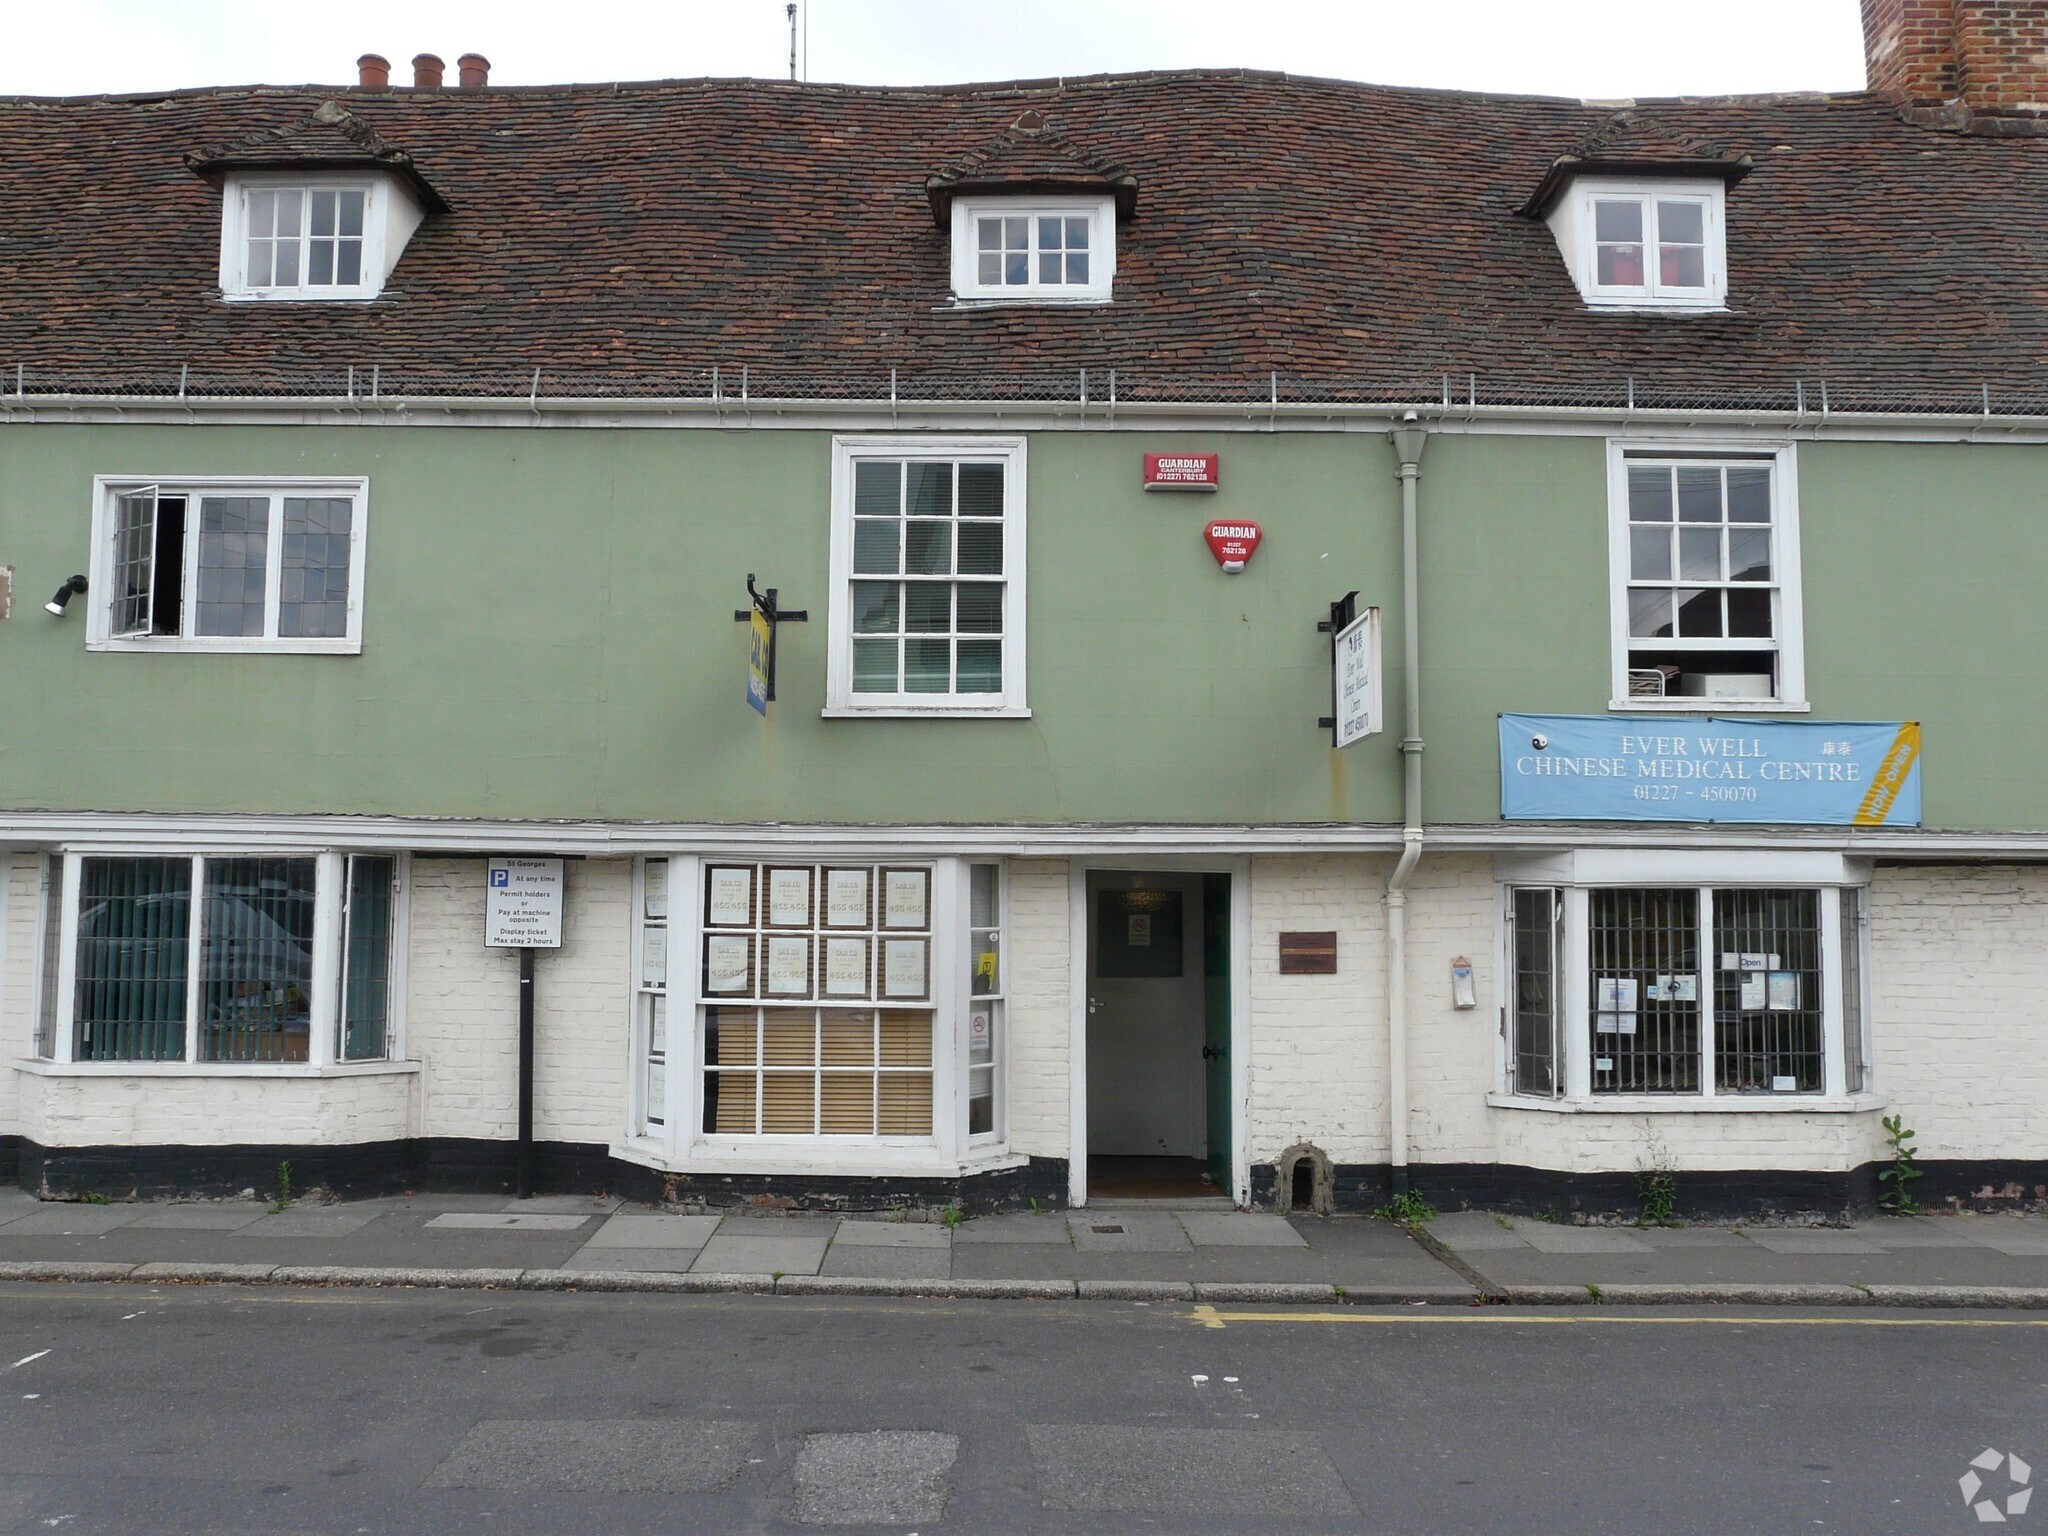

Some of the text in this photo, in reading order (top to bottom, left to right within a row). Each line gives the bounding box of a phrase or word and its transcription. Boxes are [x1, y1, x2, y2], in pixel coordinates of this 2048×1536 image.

[1158, 458, 1206, 468] GUARDIAN
[1157, 472, 1181, 480] (01227)
[1212, 526, 1256, 539] GUARDIAN
[1622, 736, 1768, 758] EVER WELL
[1516, 756, 1860, 781] CHINESE MEDICAL CENTRE
[1867, 743, 1912, 818] NOW OPEN
[1634, 784, 1679, 800] 01227
[1700, 786, 1757, 802] 450070
[494, 871, 506, 885] P
[1741, 958, 1761, 967] Open
